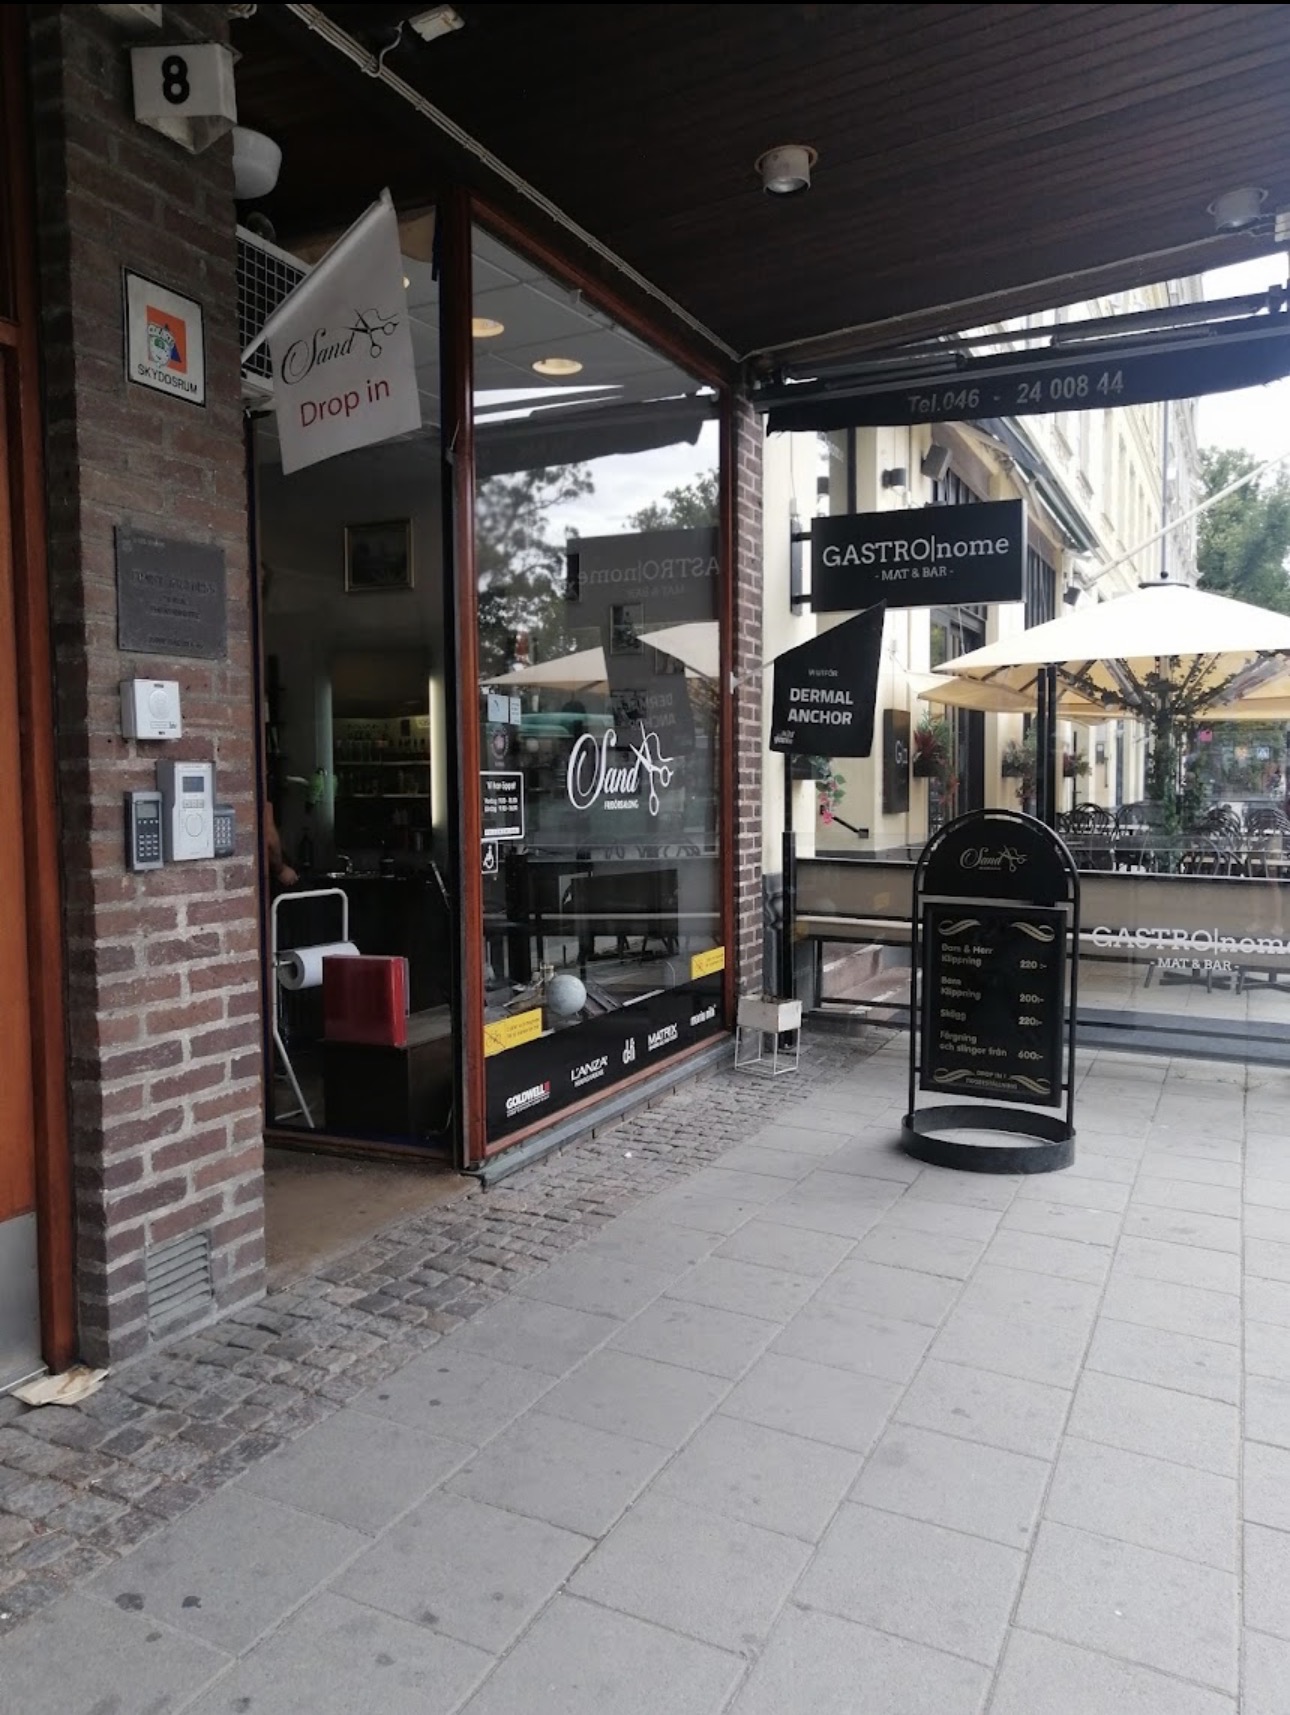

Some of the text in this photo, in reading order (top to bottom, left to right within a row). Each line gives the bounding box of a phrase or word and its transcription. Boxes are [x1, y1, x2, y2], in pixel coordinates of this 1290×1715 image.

[161, 54, 191, 105] 8
[281, 327, 356, 385] Sand
[137, 363, 198, 394] SKYDDSRUM
[908, 388, 981, 414] Tel.046
[1016, 380, 1042, 404] 24
[1049, 375, 1089, 400] 008
[1096, 370, 1124, 395] 44
[300, 379, 390, 427] Drop in
[881, 568, 910, 581] MAT
[911, 568, 920, 578] &
[922, 566, 947, 578] BAR
[789, 687, 854, 706] DERMAL
[788, 708, 853, 725] ANCHOR
[567, 728, 641, 809] Sand
[963, 944, 971, 954] &
[972, 945, 994, 955] Herr
[941, 954, 982, 968] Klippning
[1020, 959, 1038, 970] 220
[1157, 957, 1189, 968] MAT
[1192, 959, 1200, 969] &
[1203, 959, 1232, 971] BAR
[941, 987, 982, 1001] Klippning
[939, 1042, 955, 1052] och
[956, 1044, 986, 1059] slingor
[988, 1046, 1008, 1057] från
[505, 1083, 545, 1109] GOLDWELL
